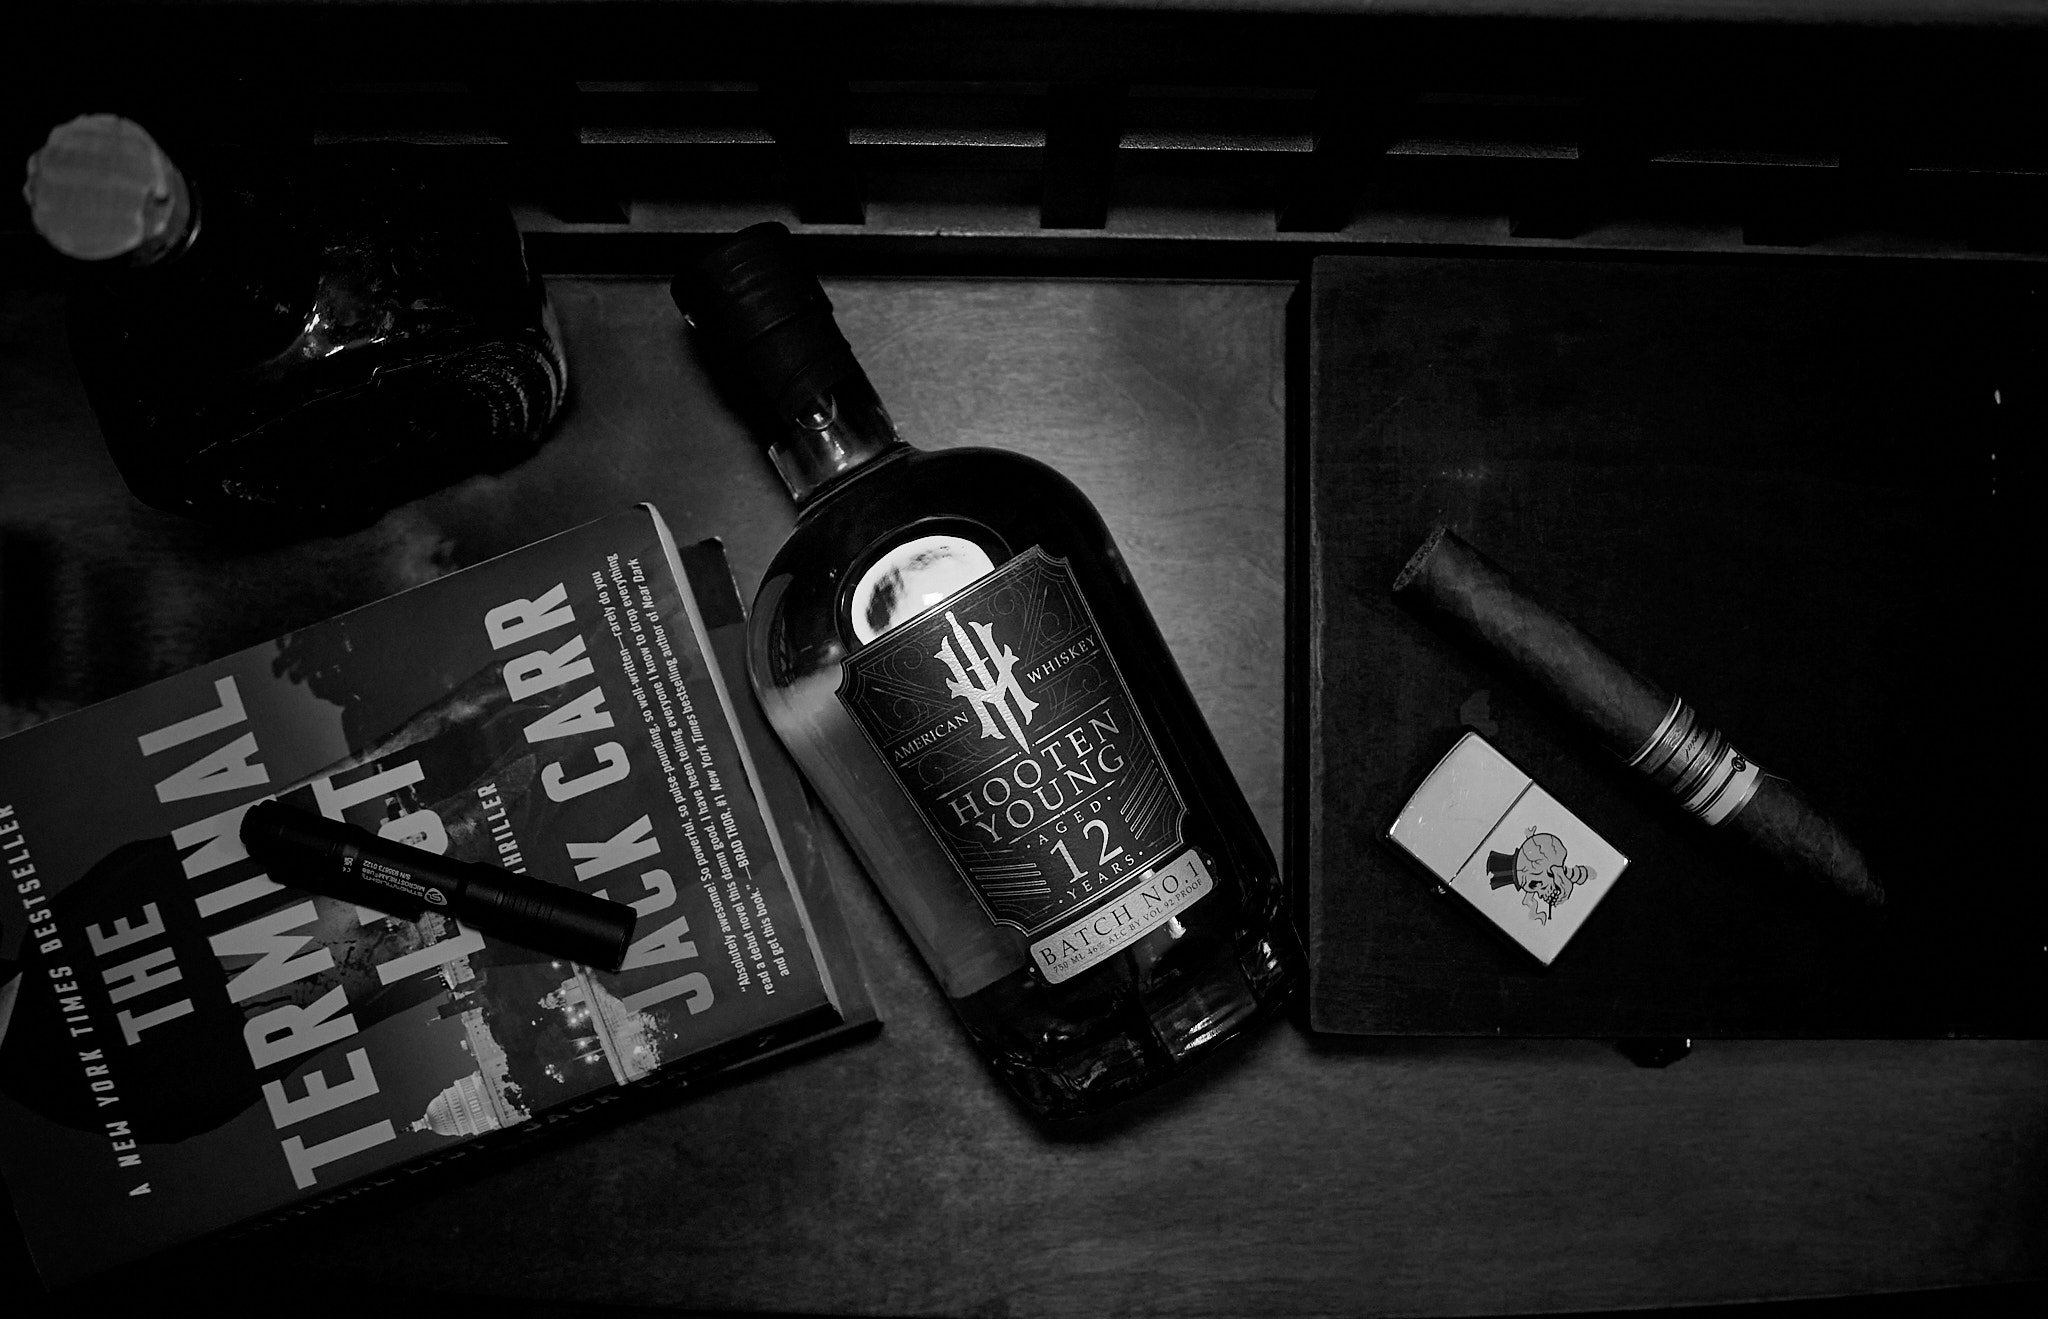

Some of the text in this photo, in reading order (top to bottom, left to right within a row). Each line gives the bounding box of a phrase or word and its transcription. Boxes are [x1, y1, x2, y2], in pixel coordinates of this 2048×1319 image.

[591, 570, 608, 591] you
[606, 552, 633, 608] everything
[627, 558, 646, 583] Dark
[598, 591, 611, 605] do
[637, 584, 655, 609] Near
[626, 608, 642, 633] drop
[645, 610, 660, 623] of
[635, 633, 647, 647] to
[652, 624, 673, 658] author
[639, 646, 658, 675] know
[1026, 634, 1096, 684] WHISKEY
[484, 581, 631, 803] CARR
[648, 674, 660, 682] I
[665, 657, 694, 715] bestselling
[642, 709, 654, 723] so
[653, 681, 678, 728] everyone
[686, 713, 705, 744] Times
[893, 711, 970, 762] AMERICAN
[671, 727, 690, 763] telling
[695, 744, 714, 769] York
[648, 723, 687, 804] pulse-pounding,
[683, 762, 700, 790] been
[948, 708, 1120, 827] HOOTEN
[706, 769, 723, 791] New
[975, 743, 1125, 844] YOUNG
[677, 804, 690, 818] so
[693, 789, 709, 816] have
[713, 794, 728, 807] #1
[703, 821, 725, 851] good.
[720, 807, 739, 840] THOR,
[1038, 800, 1102, 846] AGED
[681, 818, 709, 867] powerful,
[1050, 819, 1124, 884] 12
[700, 866, 712, 882] So
[715, 851, 734, 881] damn
[1066, 854, 1135, 900] YEARS
[726, 880, 741, 902] this
[566, 813, 715, 1016] JACK
[703, 881, 732, 933] awesome!
[731, 901, 752, 931] novel
[137, 675, 397, 1190] TERMINAL
[760, 916, 776, 938] this
[1039, 903, 1133, 966] BATCH
[1053, 962, 1069, 973] 750
[1071, 953, 1086, 965] ML
[1108, 930, 1127, 945] ALC
[1130, 920, 1142, 931] BY
[1143, 907, 1163, 920] VOL
[1164, 899, 1175, 909] 92
[1176, 878, 1203, 901] PROOF
[742, 930, 763, 961] debut
[766, 937, 785, 956] get
[85, 902, 195, 1047] THE
[755, 961, 767, 970] a
[772, 956, 790, 977] and
[756, 970, 776, 996] read
[48, 964, 95, 1039] TIMES
[78, 1048, 120, 1108] YORK
[105, 1120, 143, 1168] NEW
[128, 1182, 152, 1198] A
